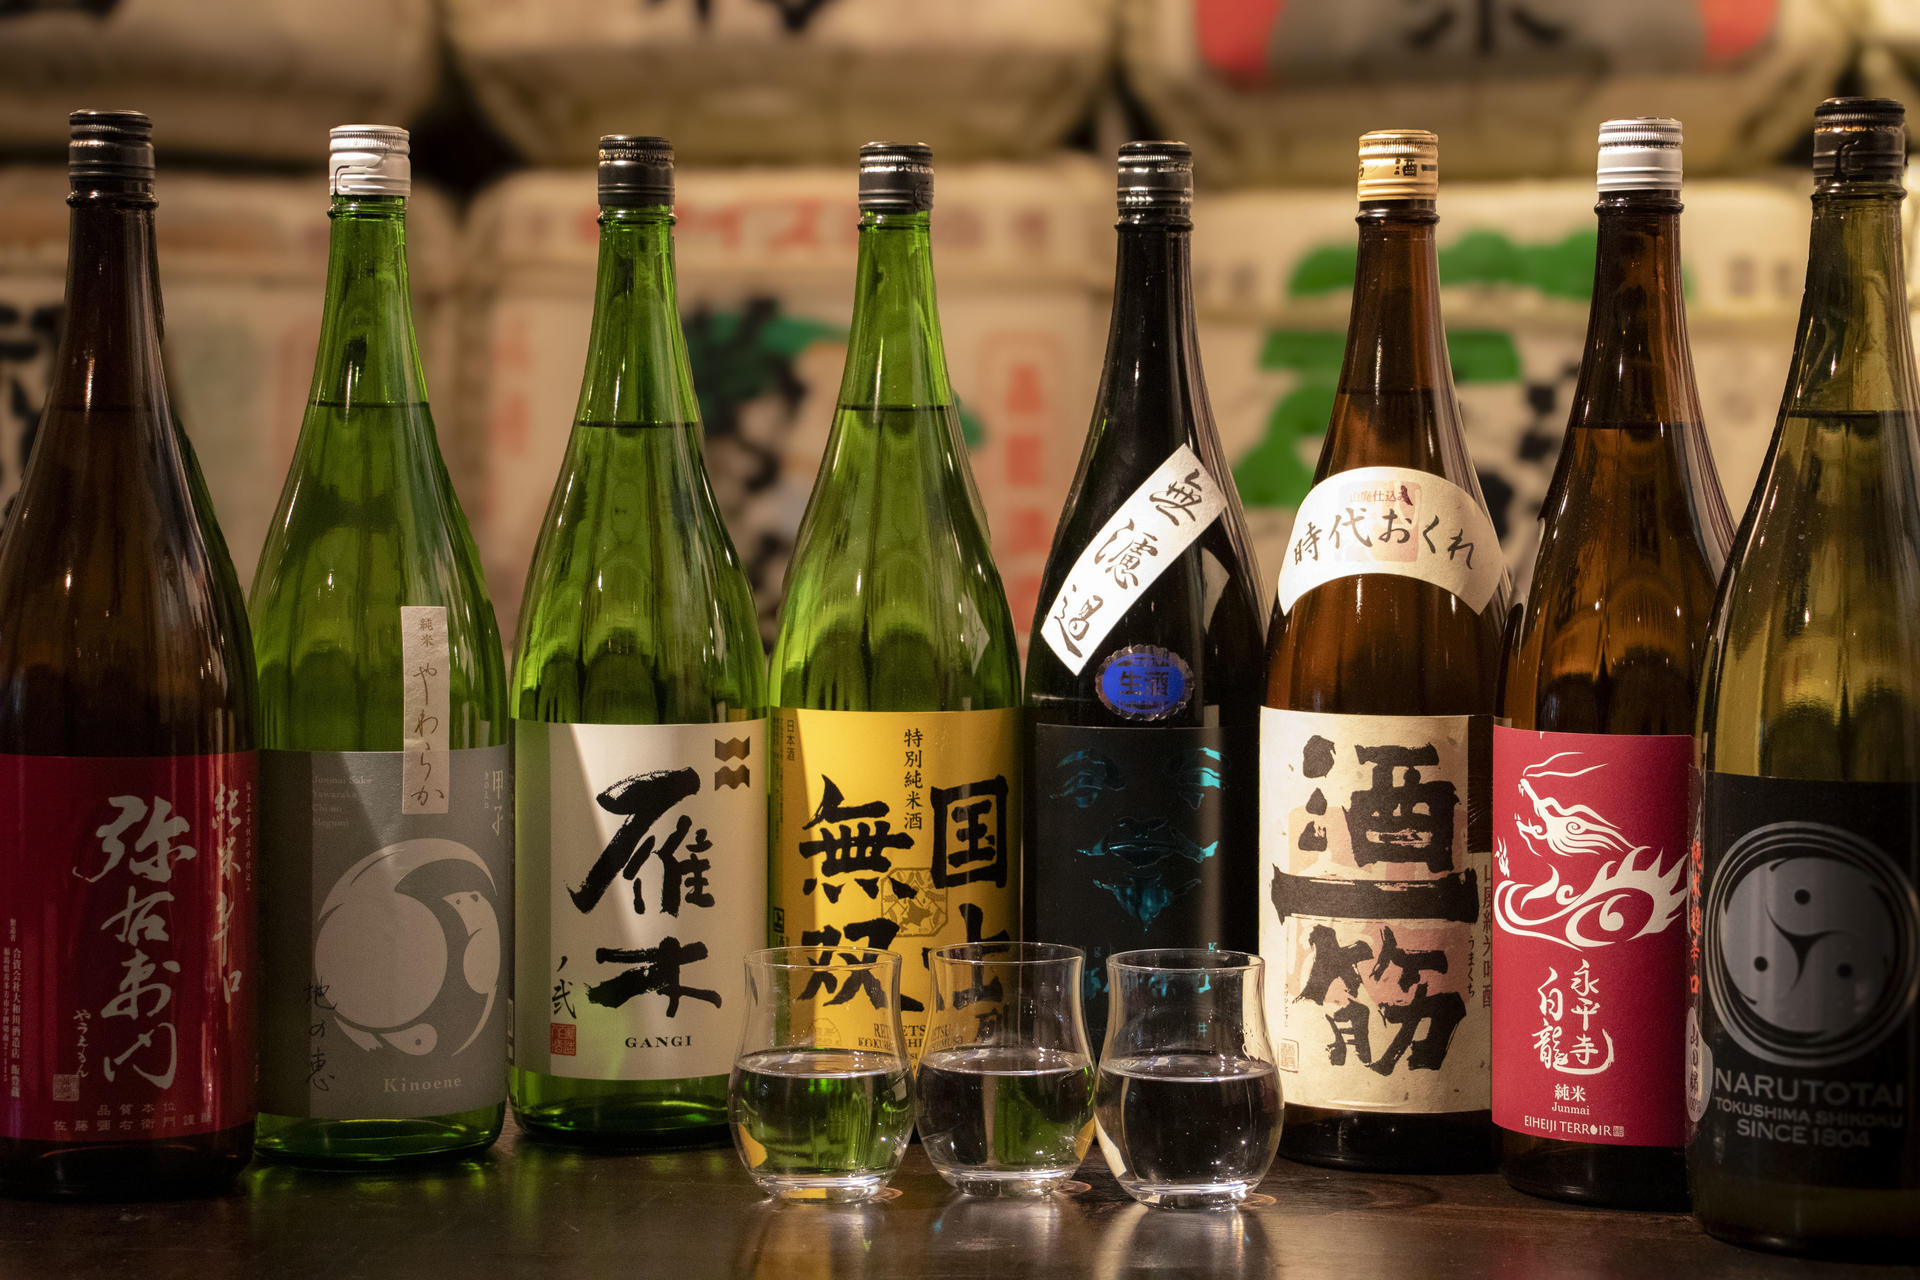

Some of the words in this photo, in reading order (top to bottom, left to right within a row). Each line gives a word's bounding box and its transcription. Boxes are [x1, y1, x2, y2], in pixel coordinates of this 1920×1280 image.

[1293, 486, 1475, 570] 時代おくれ
[419, 616, 434, 648] 純米
[411, 663, 445, 807] やわらか
[903, 728, 924, 831] 特別純米酒
[564, 766, 723, 1018] 雁木
[1270, 734, 1480, 1076] 酒一筋
[1467, 935, 1475, 997] うまくち
[303, 975, 338, 1093] 地の恵
[624, 1035, 693, 1049] GANGI
[383, 1076, 462, 1093] Kinoene
[1554, 1083, 1586, 1102] 純米
[1715, 1067, 1904, 1107] NARUTOTAI
[1524, 1115, 1557, 1133] EIHEIJI
[1551, 1101, 1590, 1116] Junmai
[1714, 1096, 1811, 1124] TOKUSHIMA
[1814, 1110, 1905, 1128] SHIKOKU
[1736, 1118, 1808, 1144] SINCE
[1812, 1126, 1871, 1148] 1804
